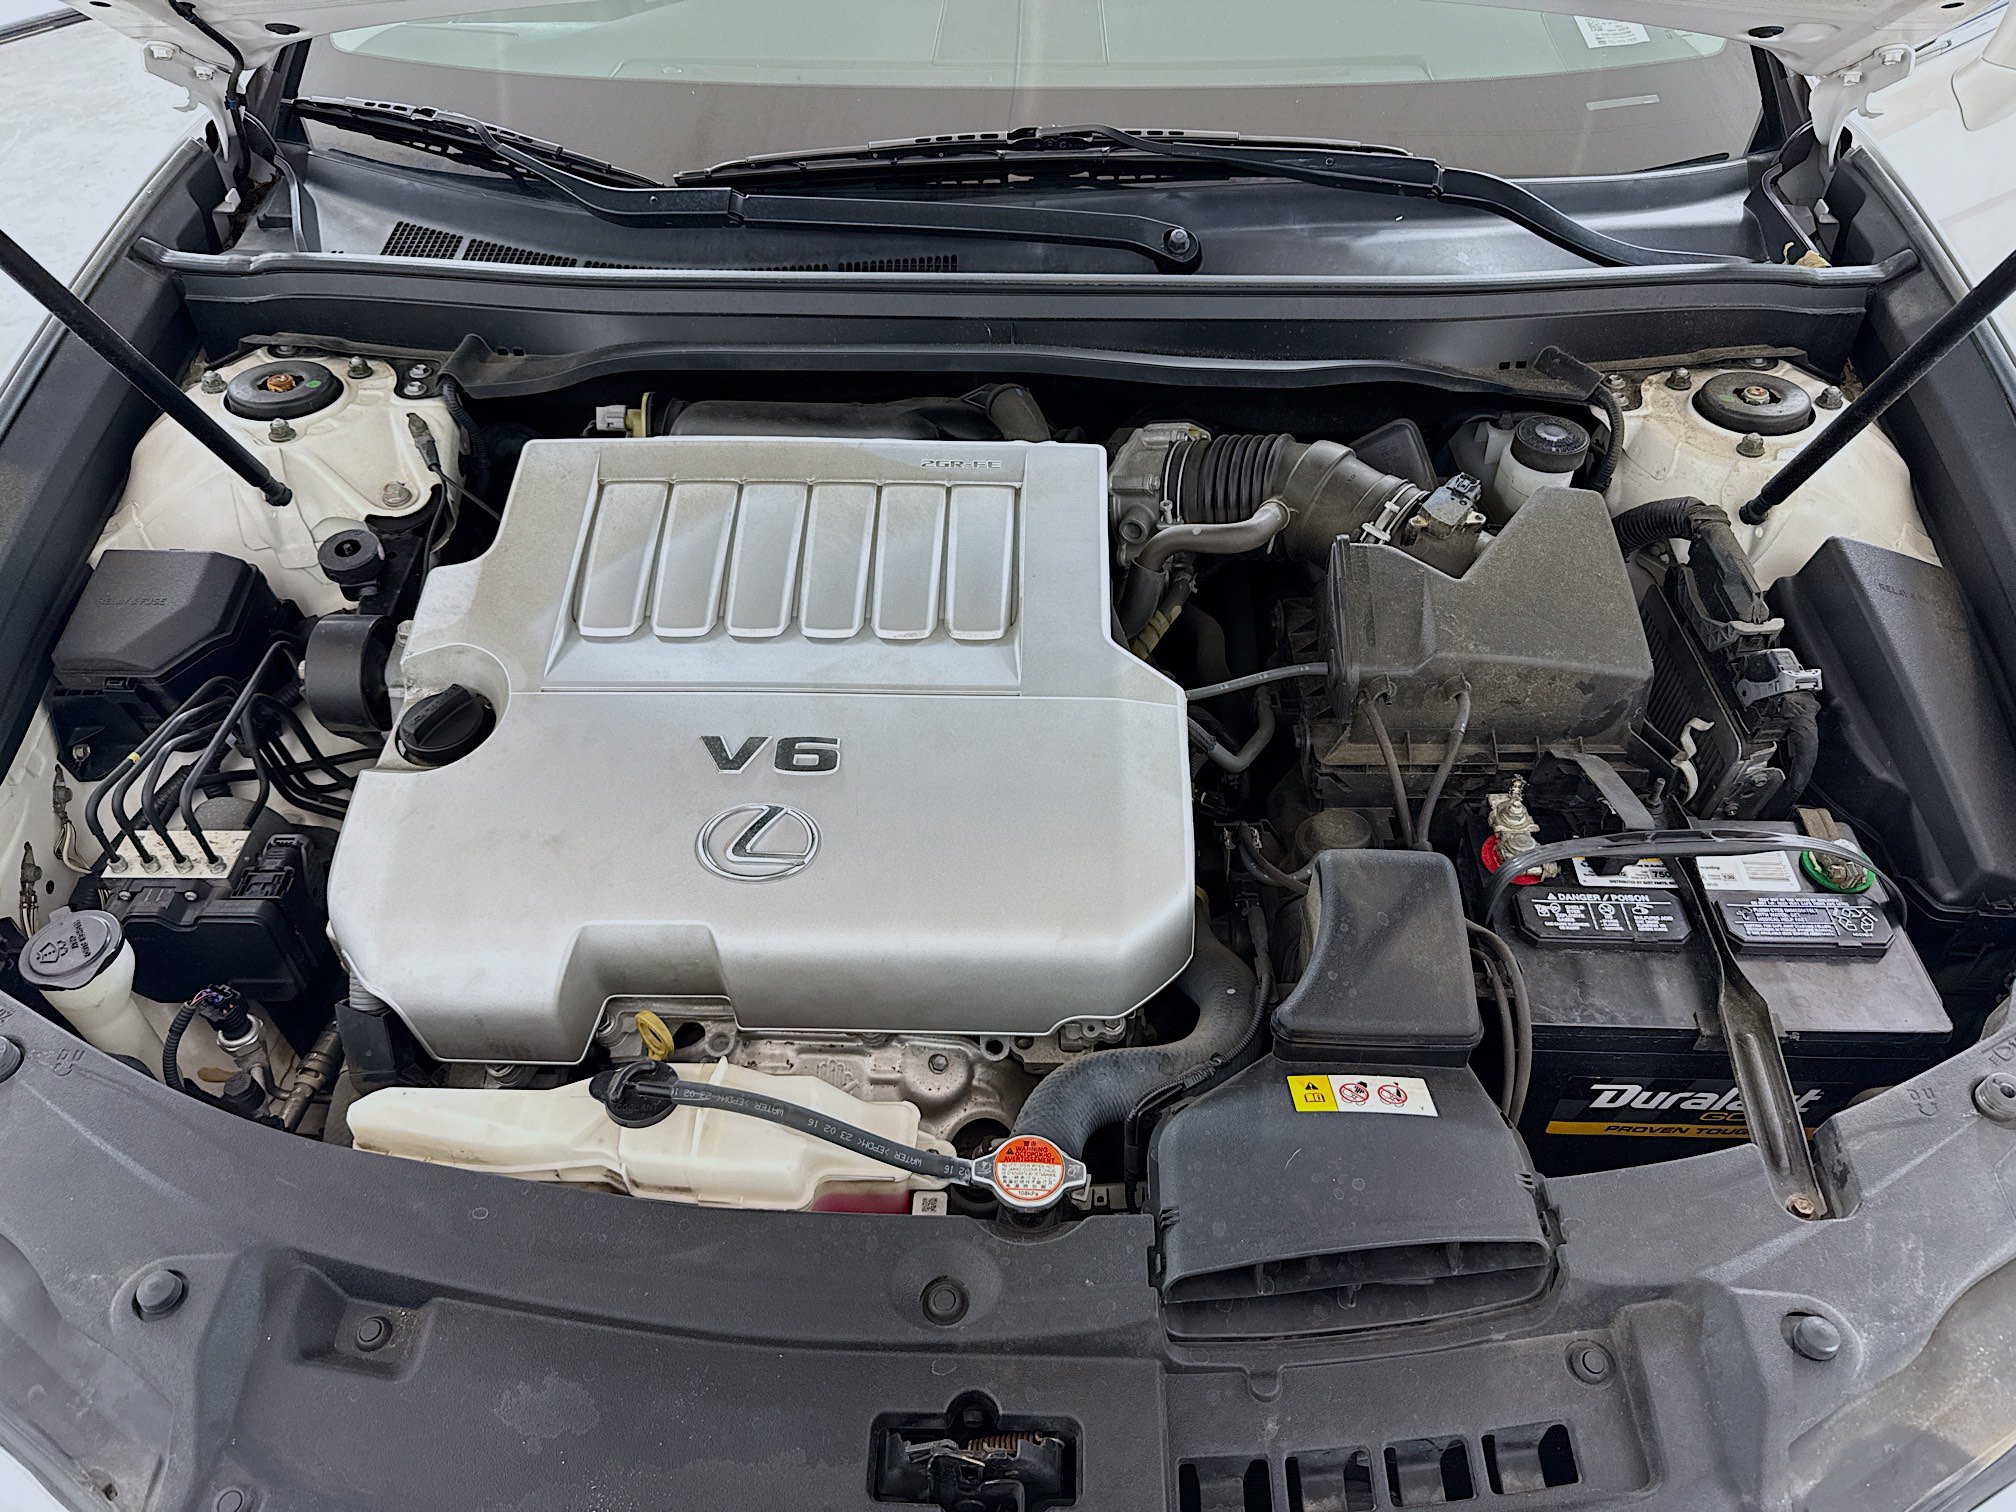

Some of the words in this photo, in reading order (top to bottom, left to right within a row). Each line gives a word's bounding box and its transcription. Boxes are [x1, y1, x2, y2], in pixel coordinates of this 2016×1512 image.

[921, 460, 1001, 469] 2GR-FE
[140, 597, 168, 606] FUSE
[699, 735, 841, 776] V6
[1652, 870, 1672, 878] 750
[1557, 892, 1601, 901] DANGER
[1602, 893, 1609, 902] /
[1610, 893, 1650, 902] POISON
[684, 1088, 697, 1098] 02
[1589, 1083, 1825, 1113] Duralt
[615, 1102, 659, 1112] COOLANT
[754, 1102, 785, 1117] WATER
[807, 1117, 819, 1128] 16
[823, 1123, 837, 1135] 02
[1603, 1125, 1690, 1135] PROVEN
[1696, 1127, 1751, 1136] TOUG
[839, 1130, 854, 1142] 23
[1015, 1145, 1049, 1153] WARNING
[893, 1149, 923, 1167] WATER
[1003, 1156, 1056, 1165] AVERTISSEMENT
[944, 1164, 954, 1174] 16
